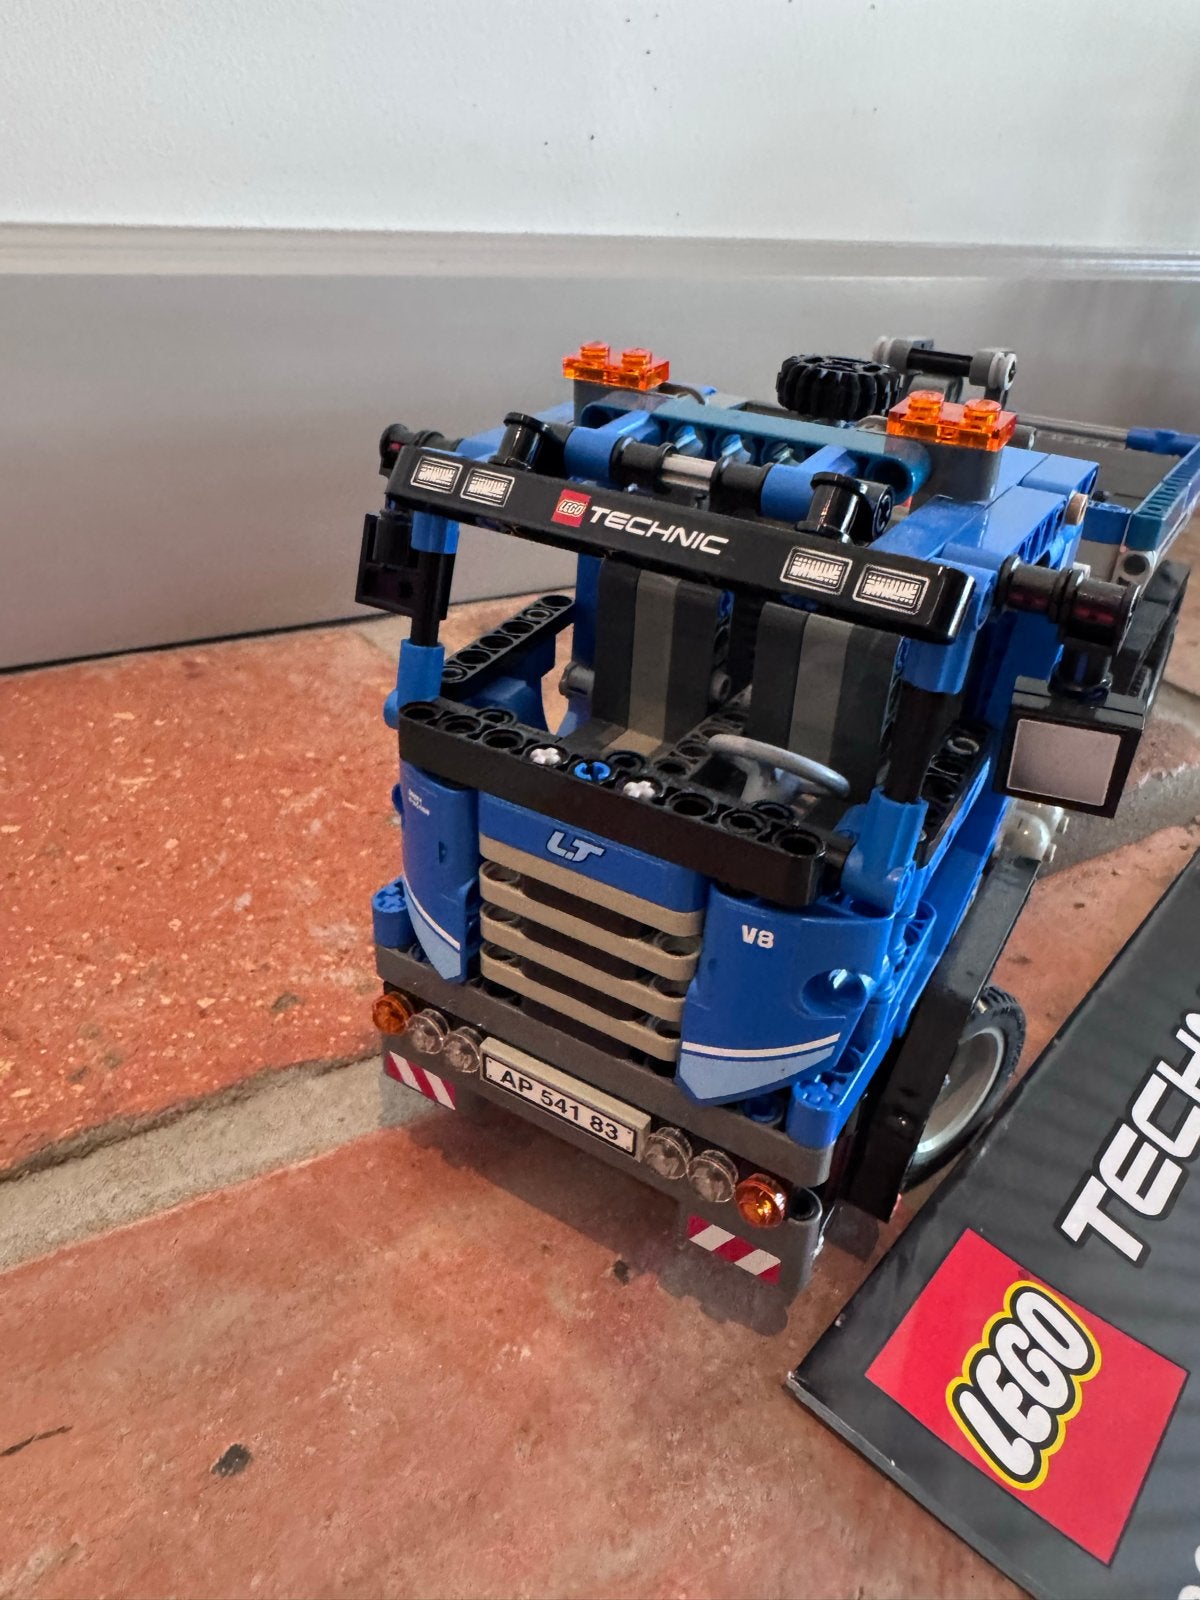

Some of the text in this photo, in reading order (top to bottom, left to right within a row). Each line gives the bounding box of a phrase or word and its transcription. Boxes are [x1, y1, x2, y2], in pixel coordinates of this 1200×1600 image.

[556, 499, 730, 555] LEGO TECHNIC
[741, 924, 775, 949] V8
[499, 1070, 619, 1141] AP 541 83
[954, 1013, 1200, 1482] LEGO TECH
